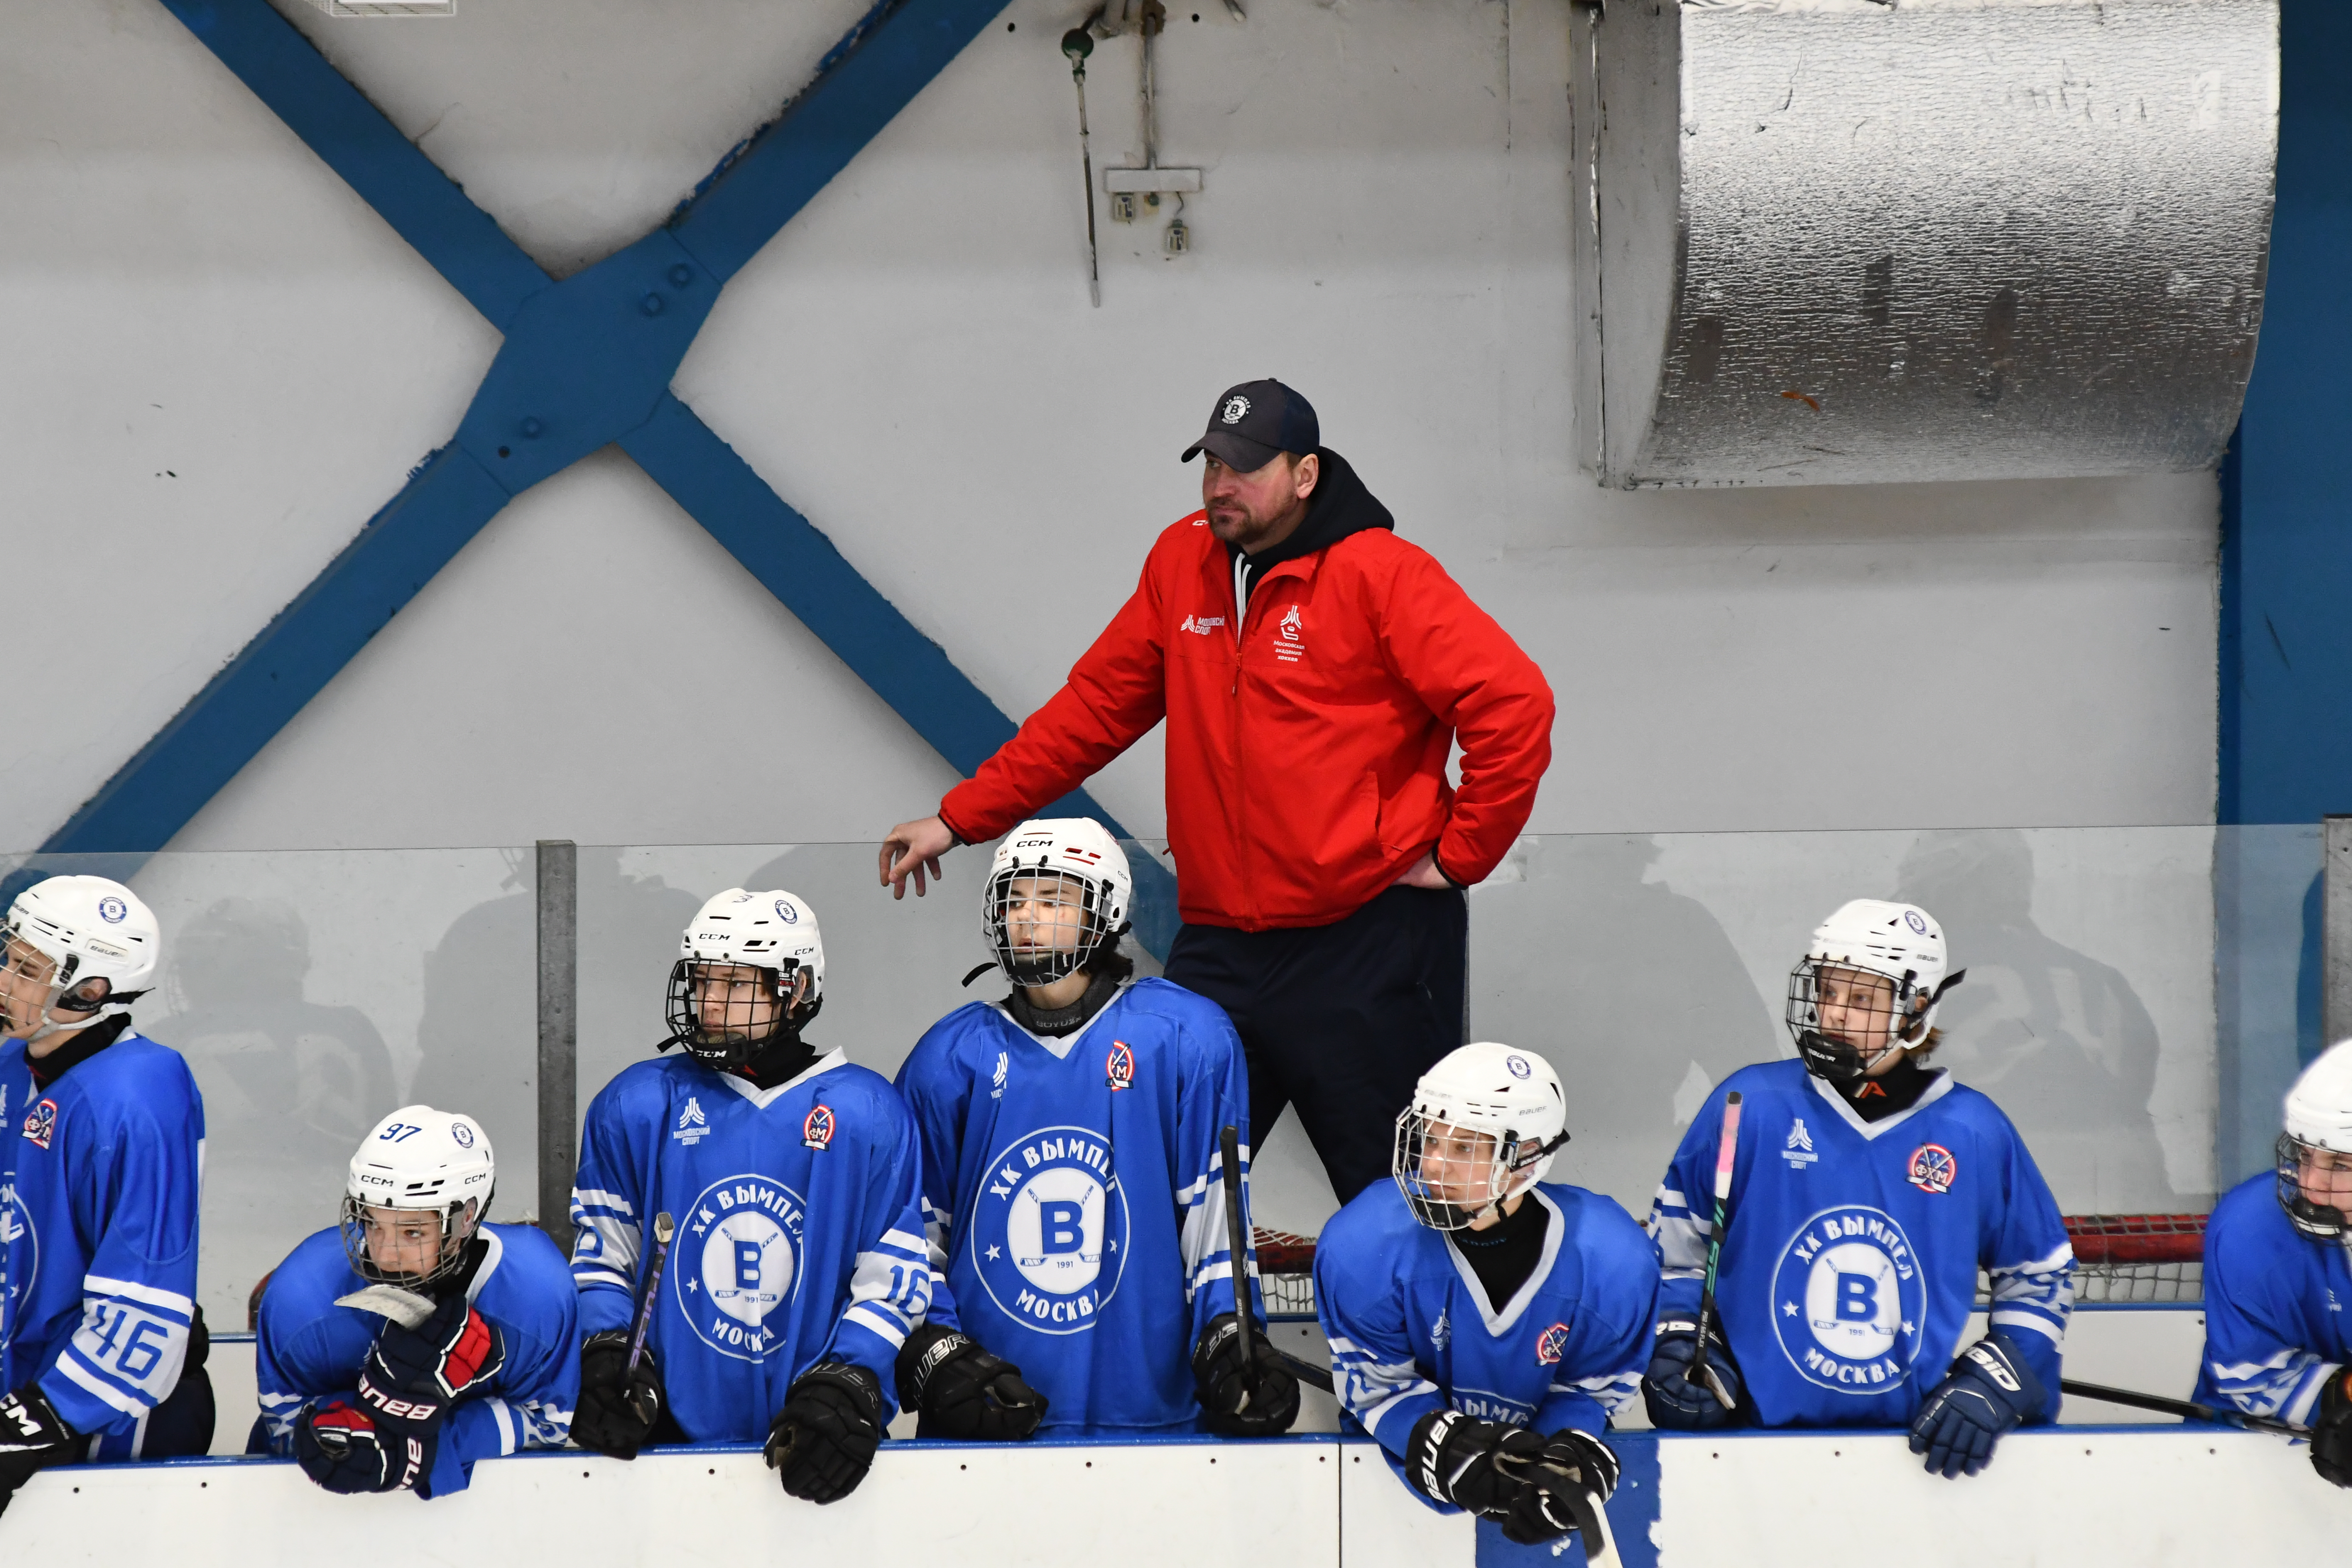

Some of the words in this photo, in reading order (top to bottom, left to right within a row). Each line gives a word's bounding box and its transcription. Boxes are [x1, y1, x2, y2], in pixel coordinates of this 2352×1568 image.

[1273, 640, 1305, 650] Московская
[1117, 870, 1128, 882] CCM
[794, 947, 814, 956] CCM
[1916, 954, 1938, 962] BAUER
[1519, 1106, 1547, 1116] BAUER
[379, 1123, 422, 1143] 97
[673, 1125, 710, 1139] МОСКОВСКИЙ
[682, 1136, 700, 1146] СПОРТ
[464, 1173, 486, 1185] CCM
[1915, 1164, 1949, 1183] ФХМ
[360, 1175, 394, 1187] CCM
[990, 1163, 1022, 1201] ХК
[691, 1203, 717, 1239] ХК
[1795, 1231, 1823, 1265] ХК
[1824, 1216, 1914, 1280] ВЫМПЕЛ
[1056, 1260, 1074, 1269] 1991
[887, 1265, 929, 1321] 16
[744, 1296, 759, 1304] 1991
[1849, 1328, 1865, 1337] 1991
[89, 1304, 169, 1380] 46
[1805, 1347, 1900, 1384] МОСКВА
[1421, 1410, 1465, 1503] BAUER
